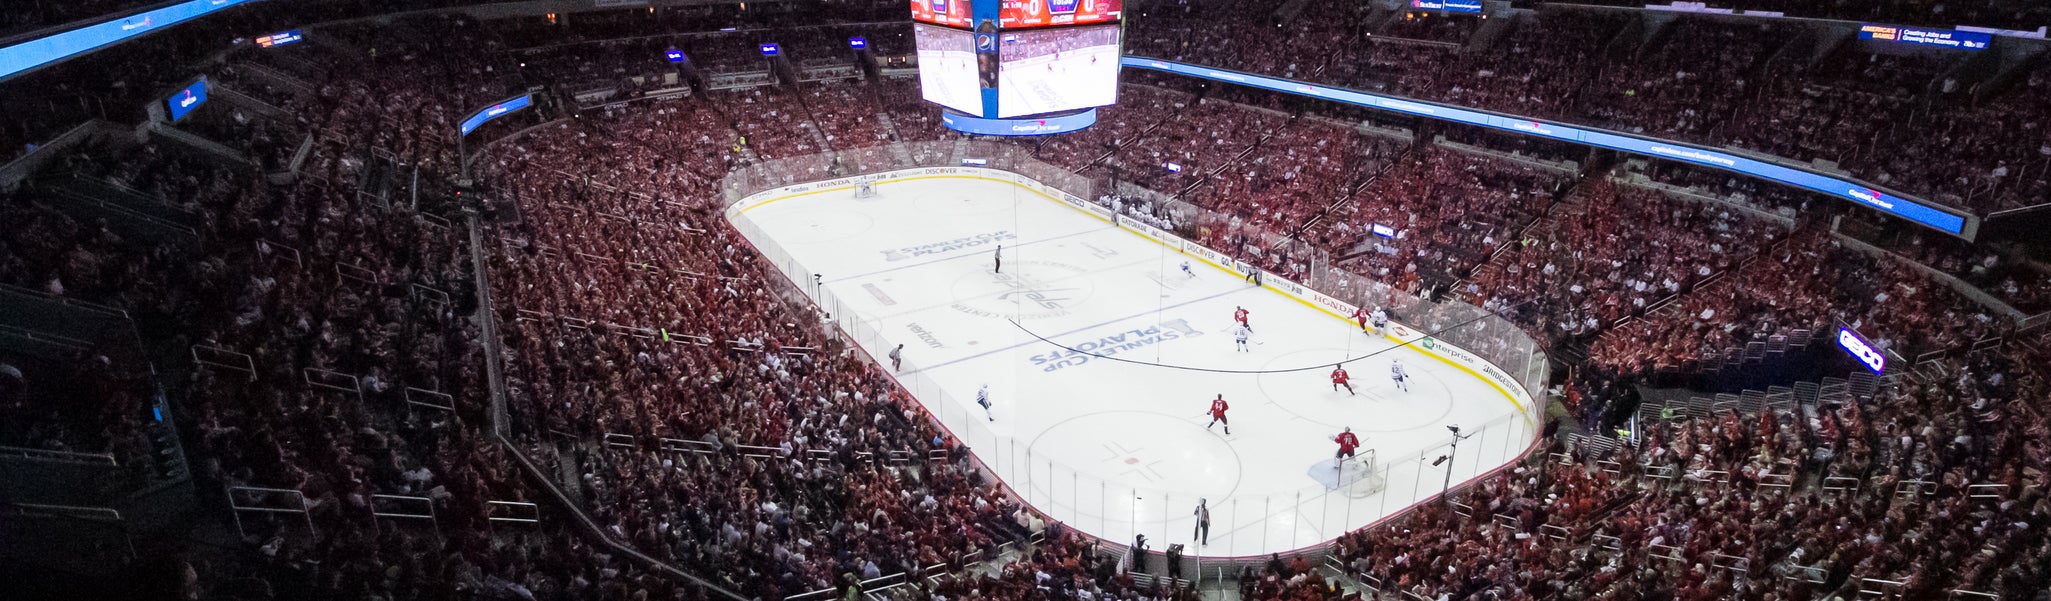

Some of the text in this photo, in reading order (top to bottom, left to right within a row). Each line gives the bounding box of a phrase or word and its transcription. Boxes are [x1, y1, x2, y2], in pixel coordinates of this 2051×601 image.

[1902, 35, 1925, 43] Growing
[1934, 38, 1960, 46] Economy
[1903, 29, 1925, 37] Creating
[816, 180, 850, 189] HONDA
[1064, 194, 1085, 207] GEICO
[1121, 217, 1147, 232] GATORADE
[900, 237, 971, 253] STANLEY
[913, 233, 1017, 257] PLAYOFFS
[1186, 243, 1215, 260] DISCOVER
[1314, 294, 1355, 316] HONDA
[1029, 325, 1160, 365] PLAYOFFS
[1043, 330, 1179, 372] STANLEY CUP
[1840, 329, 1884, 371] GEICO
[1483, 364, 1522, 398] BRIDGESTONE
